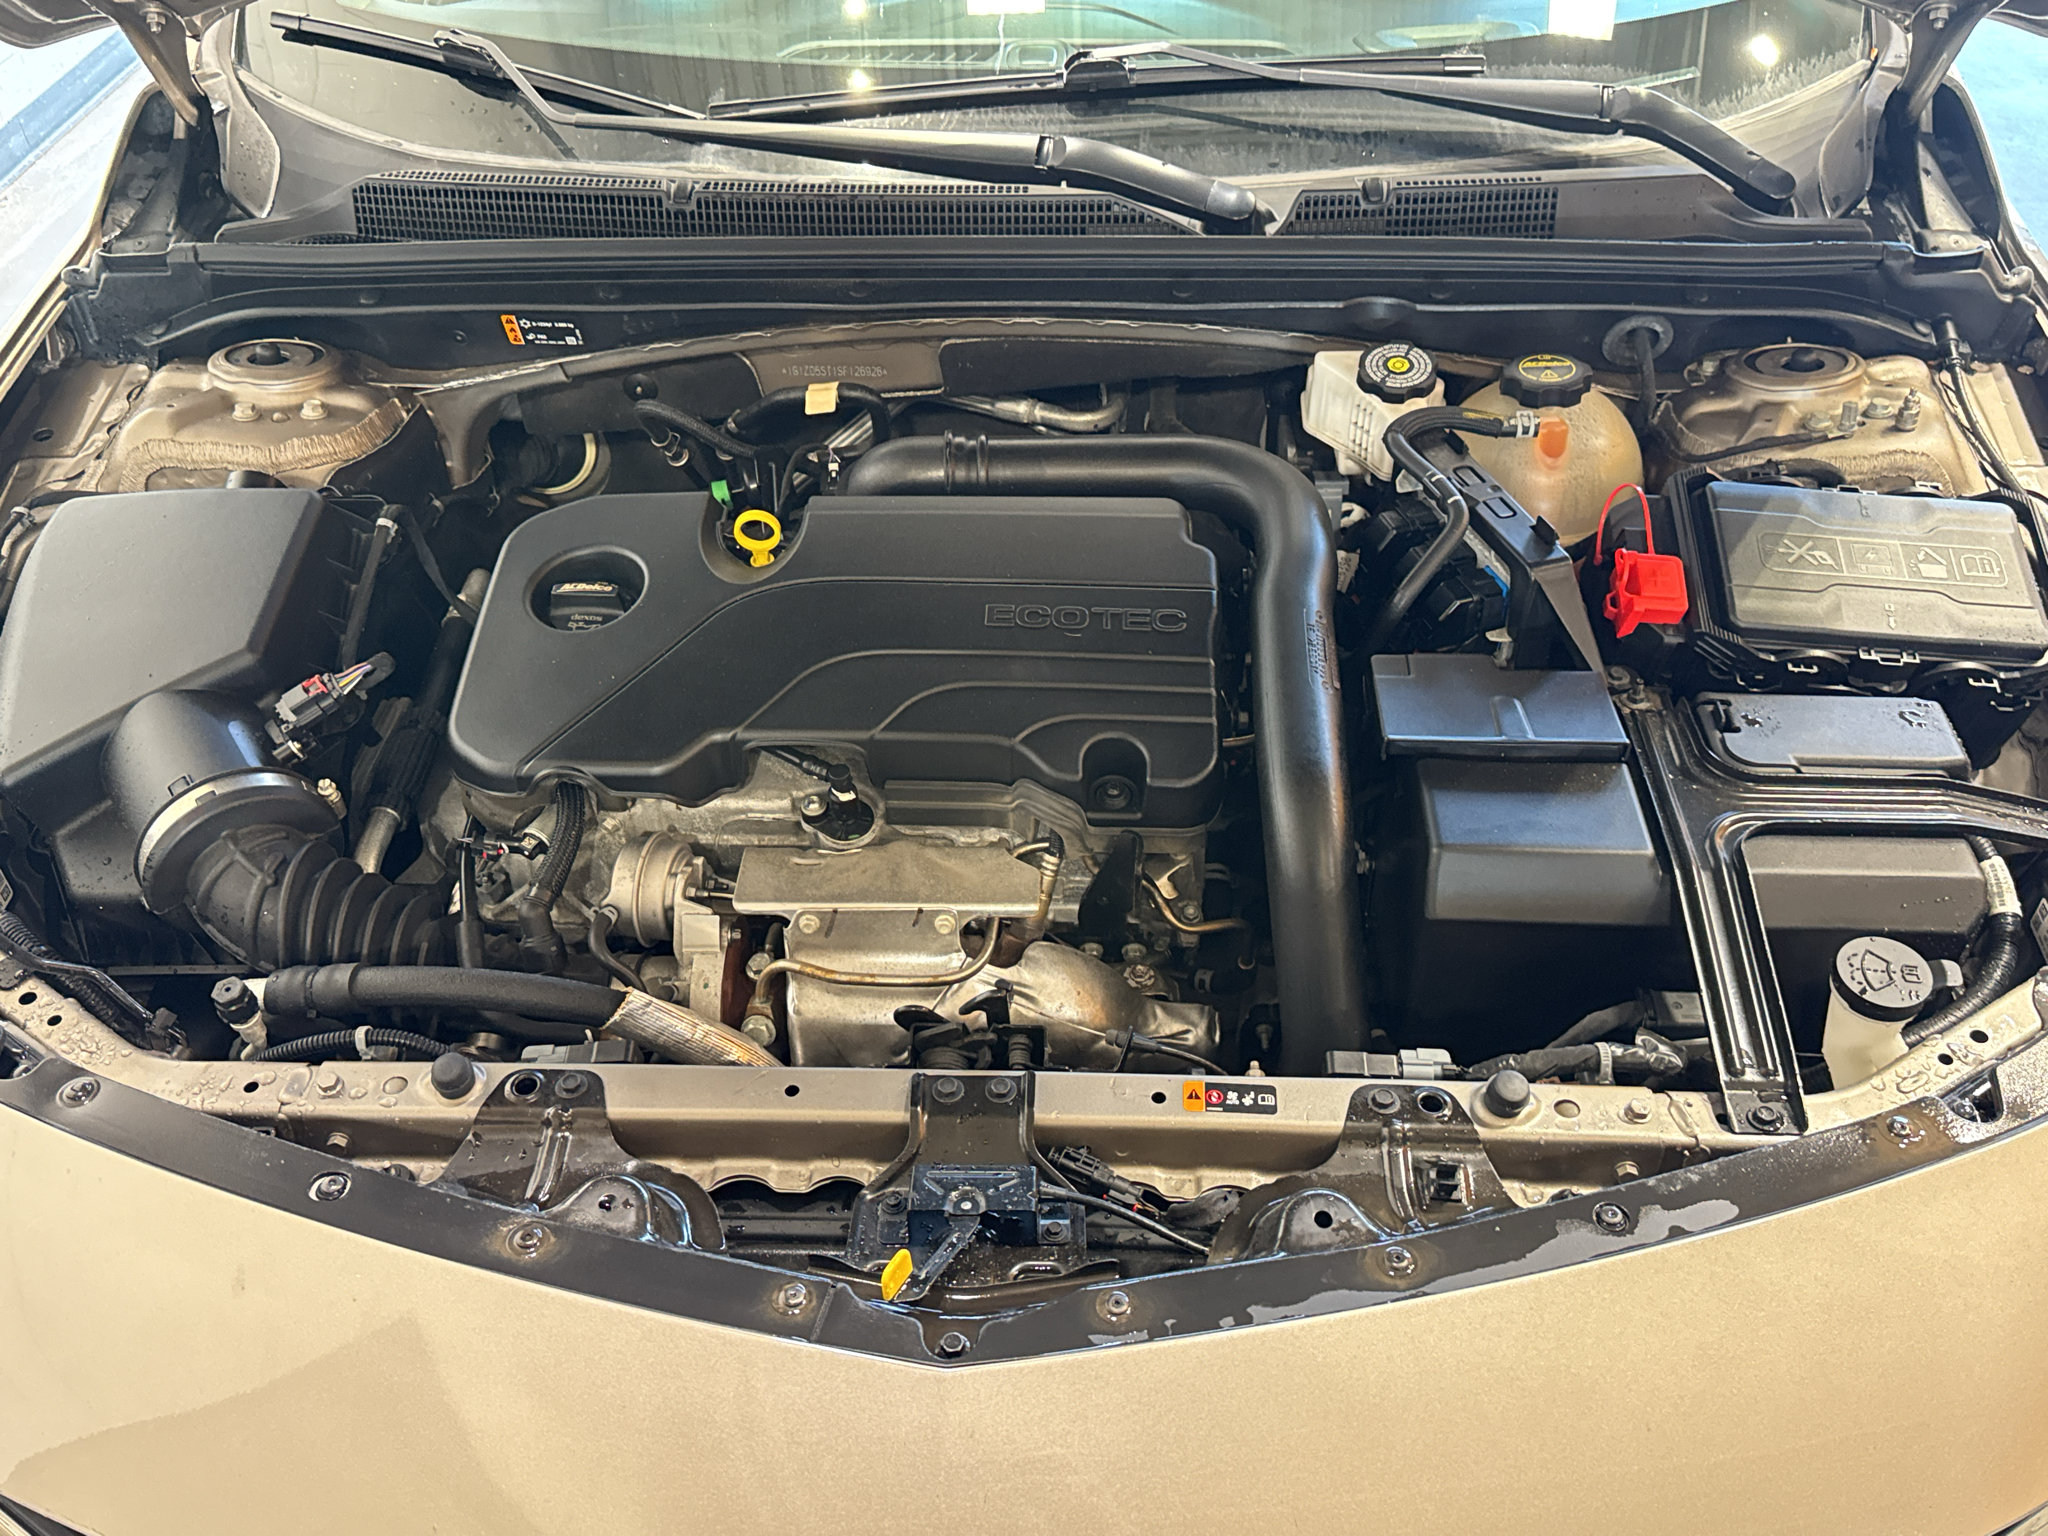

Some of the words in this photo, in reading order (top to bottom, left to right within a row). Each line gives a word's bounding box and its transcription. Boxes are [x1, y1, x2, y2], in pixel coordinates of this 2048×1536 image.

[556, 583, 613, 592] ACDelco
[570, 613, 603, 621] dexos
[984, 603, 1187, 635] ECOTEC
